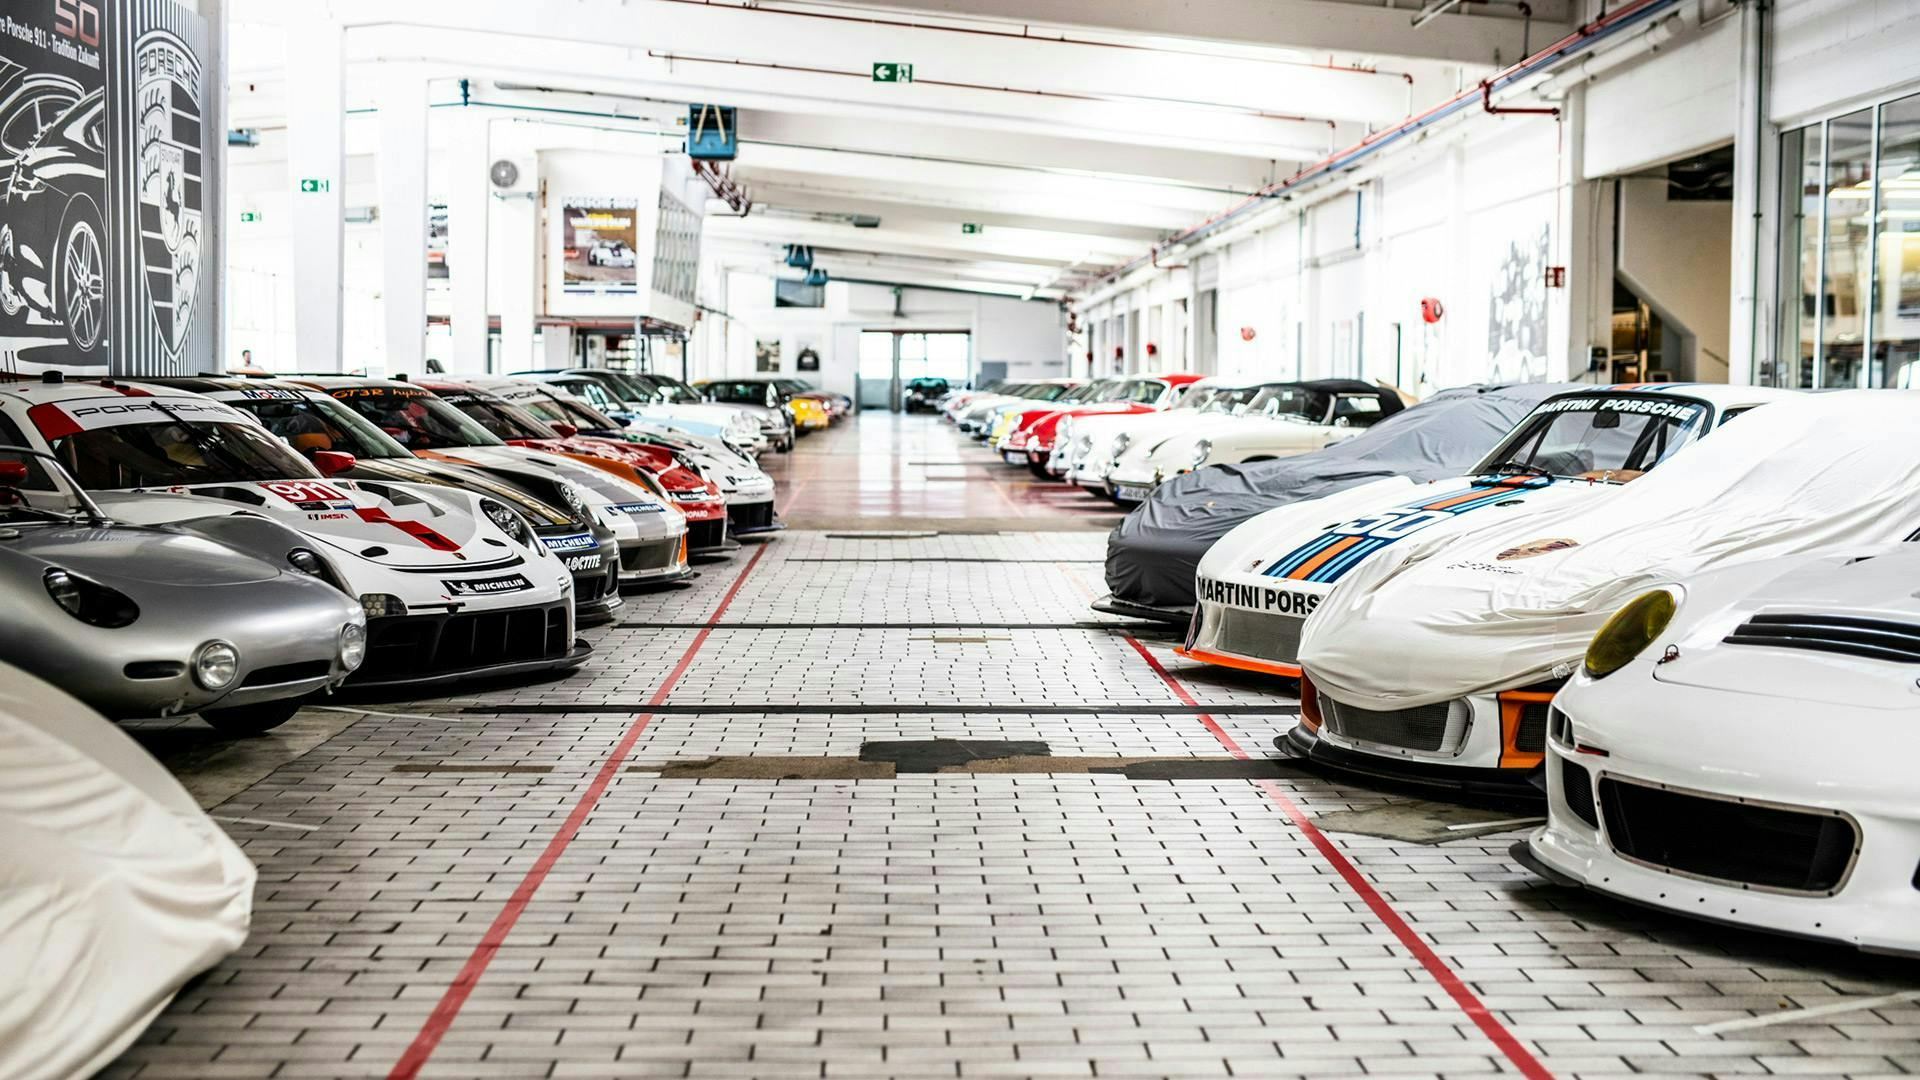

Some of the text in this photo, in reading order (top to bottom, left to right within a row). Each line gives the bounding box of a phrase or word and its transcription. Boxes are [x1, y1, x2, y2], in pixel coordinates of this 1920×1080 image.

[7, 15, 33, 44] Porsche
[34, 26, 47, 49] 911
[55, 0, 99, 48] 50
[139, 48, 199, 104] PORSCHE
[241, 389, 291, 399] Mobil
[72, 403, 235, 418] PORSCHE
[1536, 399, 1599, 413] MARTINI
[1600, 399, 1697, 420] PORSCHE
[267, 482, 342, 500] 911
[623, 504, 659, 512] MICHELIN
[546, 536, 595, 548] MICHELIN
[565, 554, 601, 570] LOCTITE
[474, 578, 525, 591] MICHELIN
[1197, 577, 1320, 616] MARTINI PORS
